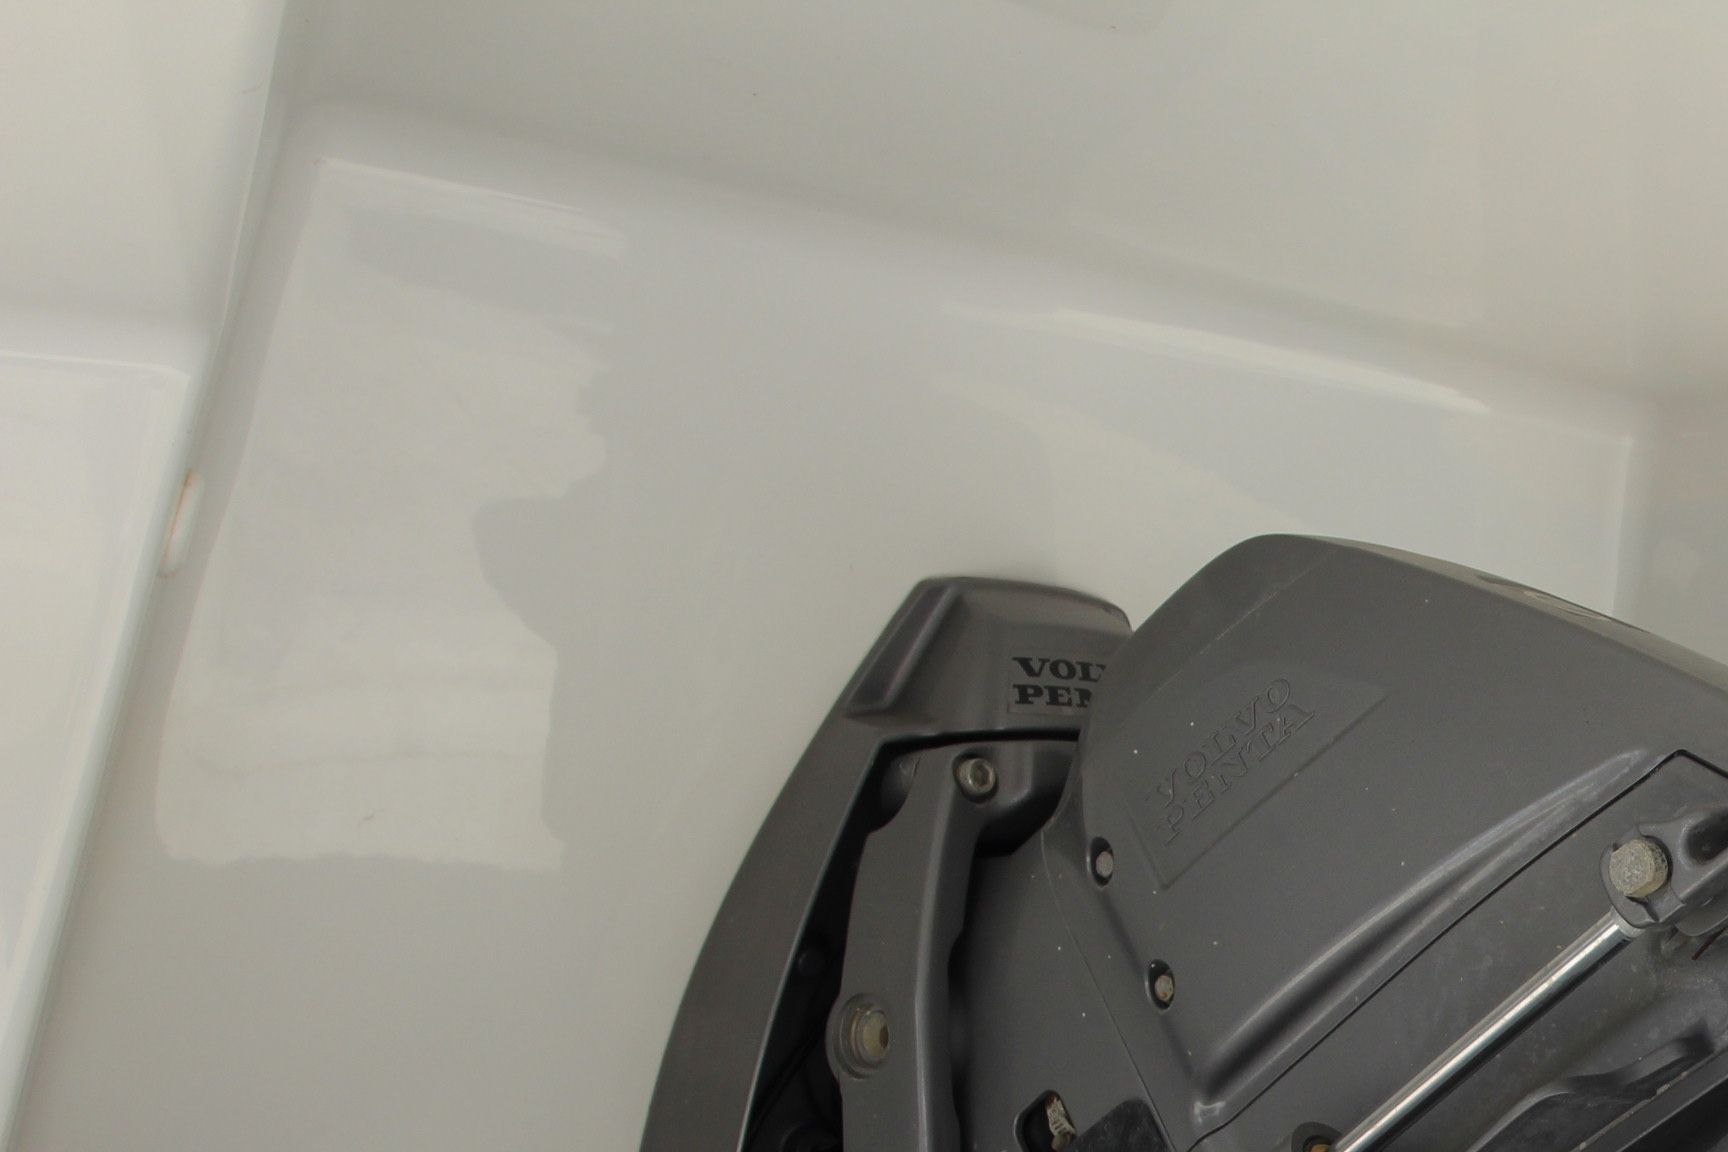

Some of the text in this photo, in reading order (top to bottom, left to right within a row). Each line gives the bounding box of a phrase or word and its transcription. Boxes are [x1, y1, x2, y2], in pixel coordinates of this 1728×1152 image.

[1012, 657, 1106, 682] VOL
[1150, 679, 1292, 808] VOLVO
[1158, 704, 1316, 846] PENTA
